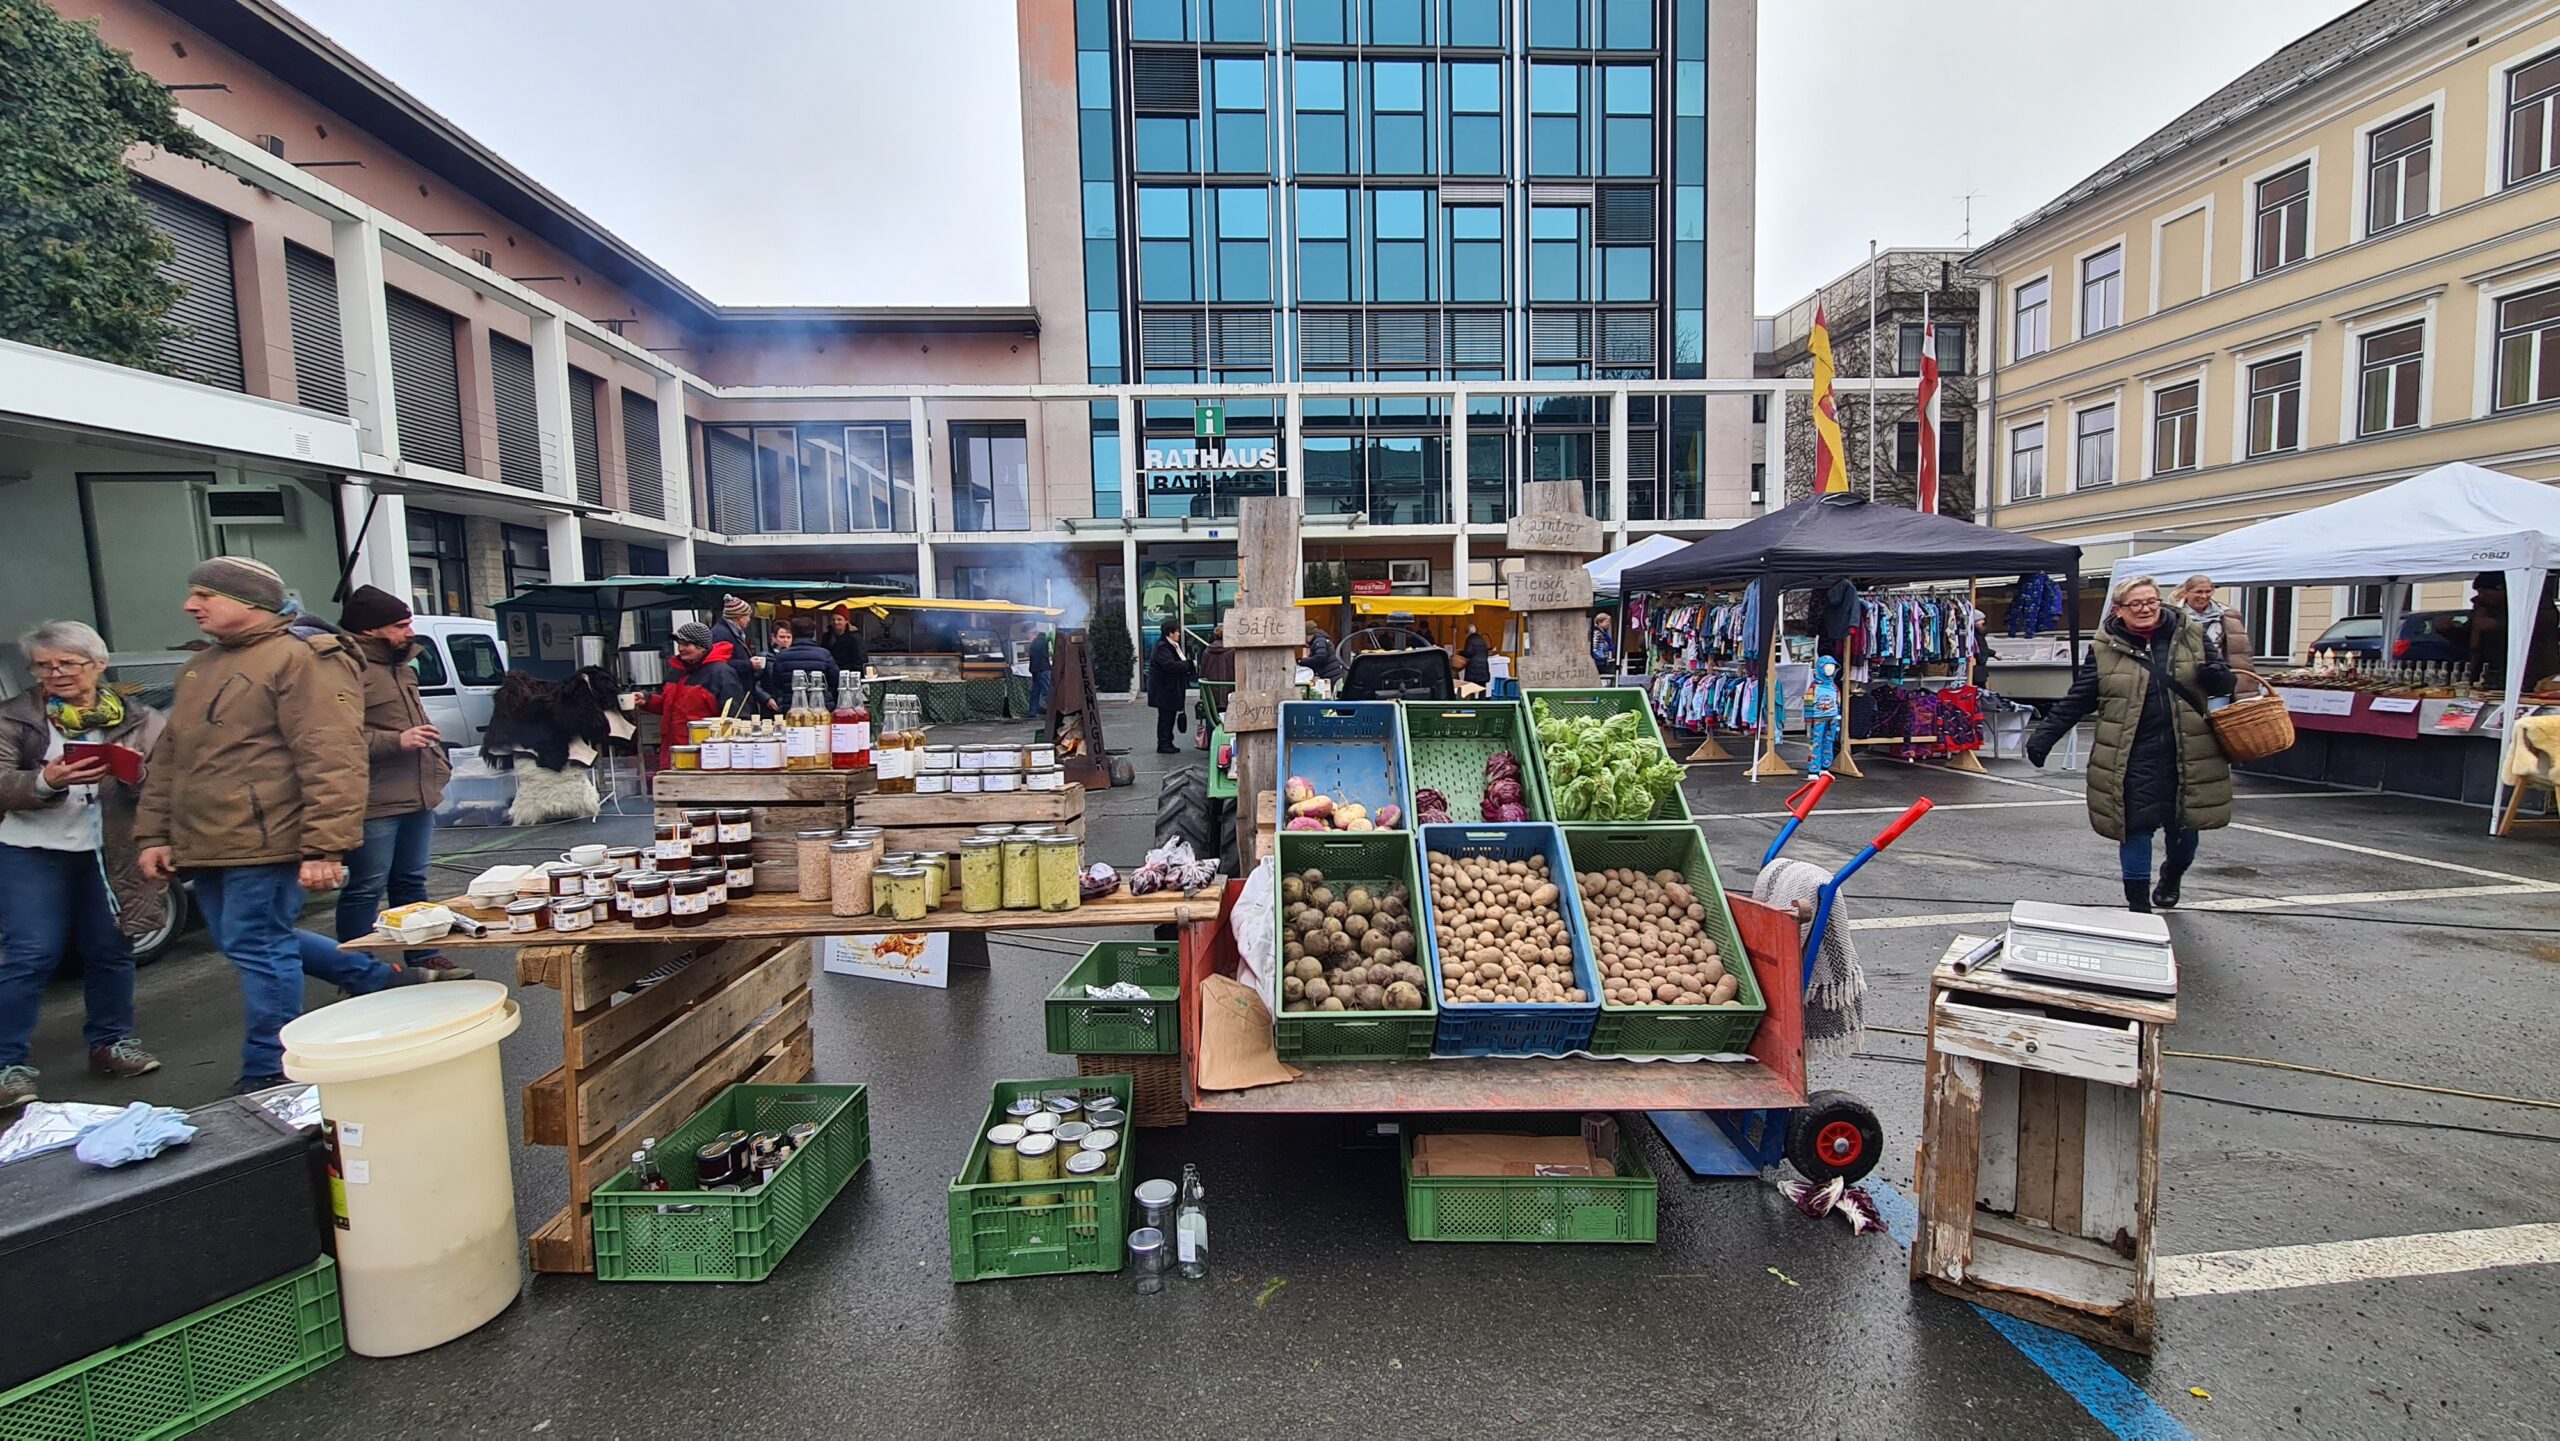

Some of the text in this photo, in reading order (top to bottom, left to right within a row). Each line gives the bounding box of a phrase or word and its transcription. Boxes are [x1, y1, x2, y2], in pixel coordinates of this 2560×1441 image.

[1144, 448, 1277, 469] RATHAUS
[2471, 552, 2510, 560] COBIZI
[1528, 591, 1569, 604] nudel
[1520, 661, 1592, 683] Sauerkraut
[1078, 649, 1105, 770] HERMAGOR
